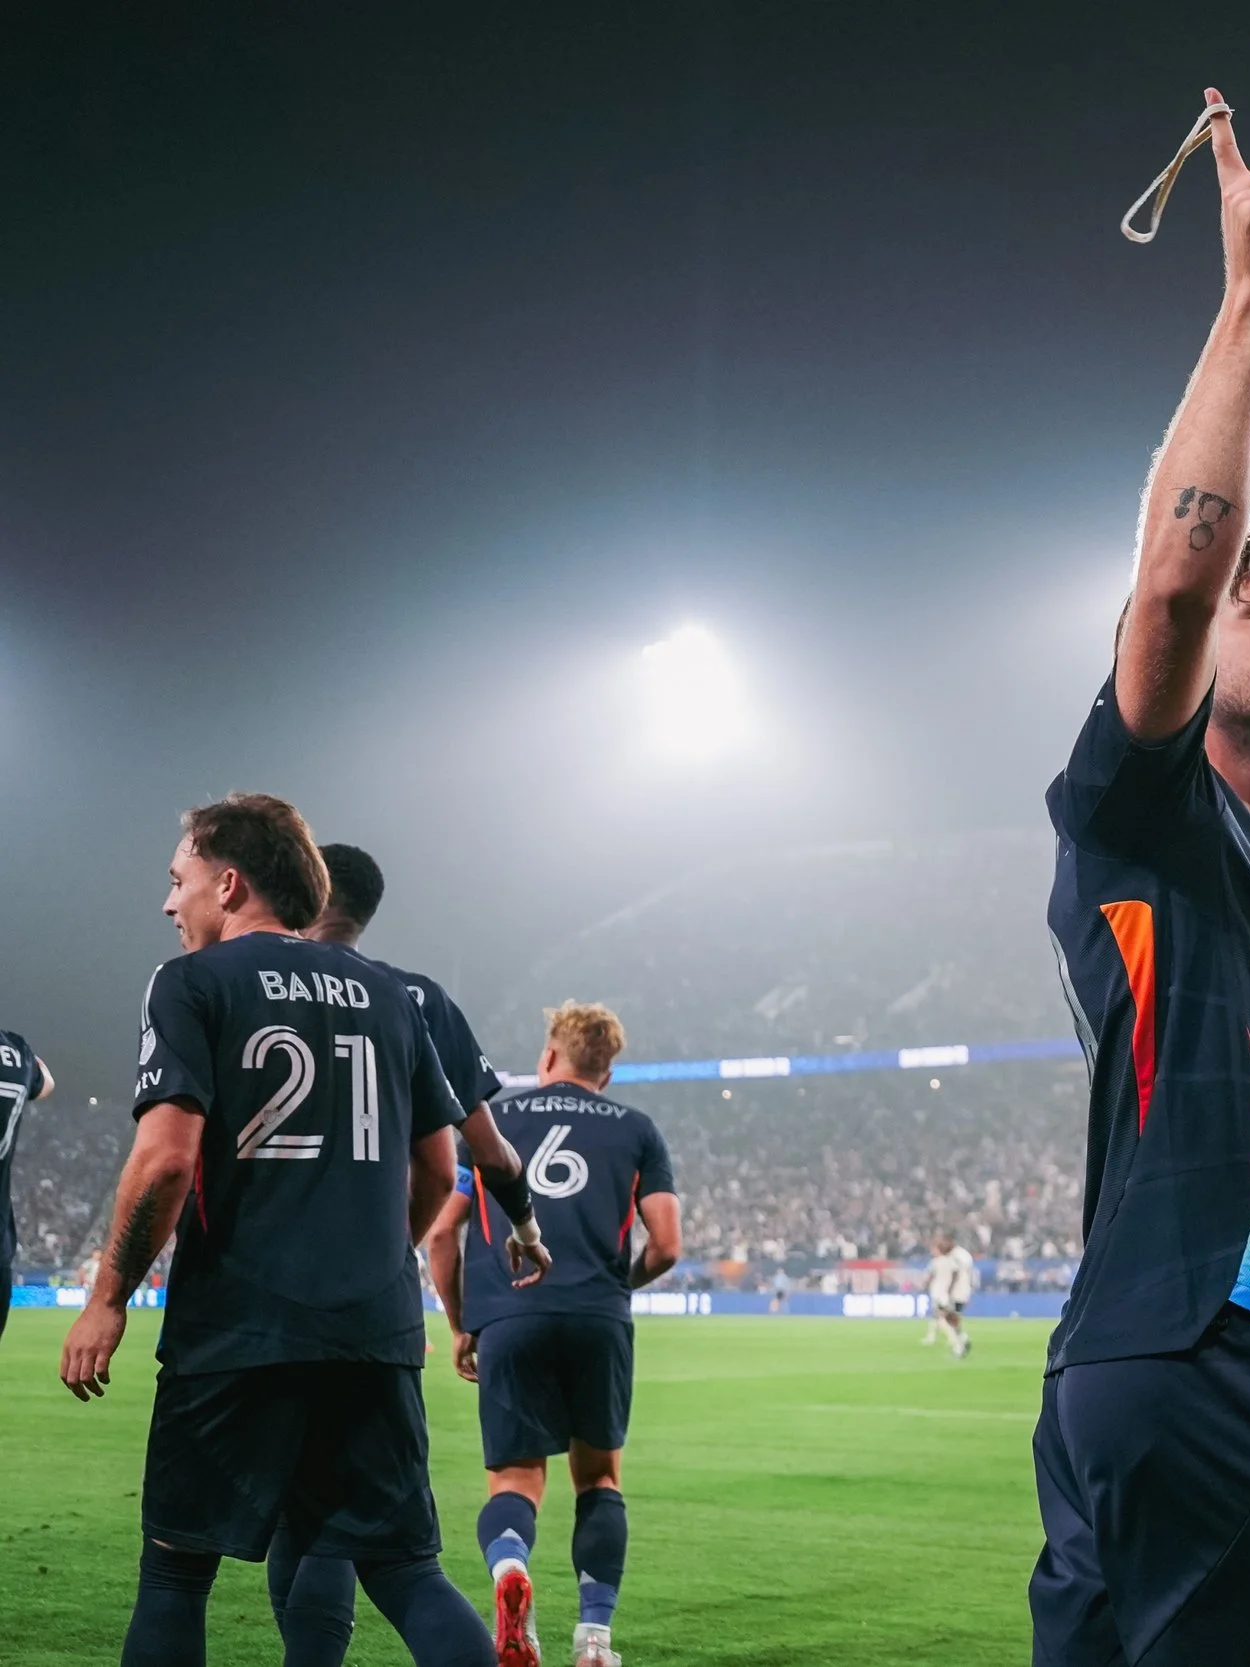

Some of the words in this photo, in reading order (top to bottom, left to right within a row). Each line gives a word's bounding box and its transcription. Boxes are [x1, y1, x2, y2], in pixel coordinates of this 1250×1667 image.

[258, 970, 370, 1009] BAIRD
[237, 1025, 380, 1162] 21
[502, 1095, 628, 1119] TVERSKOV
[526, 1125, 589, 1199] 6
